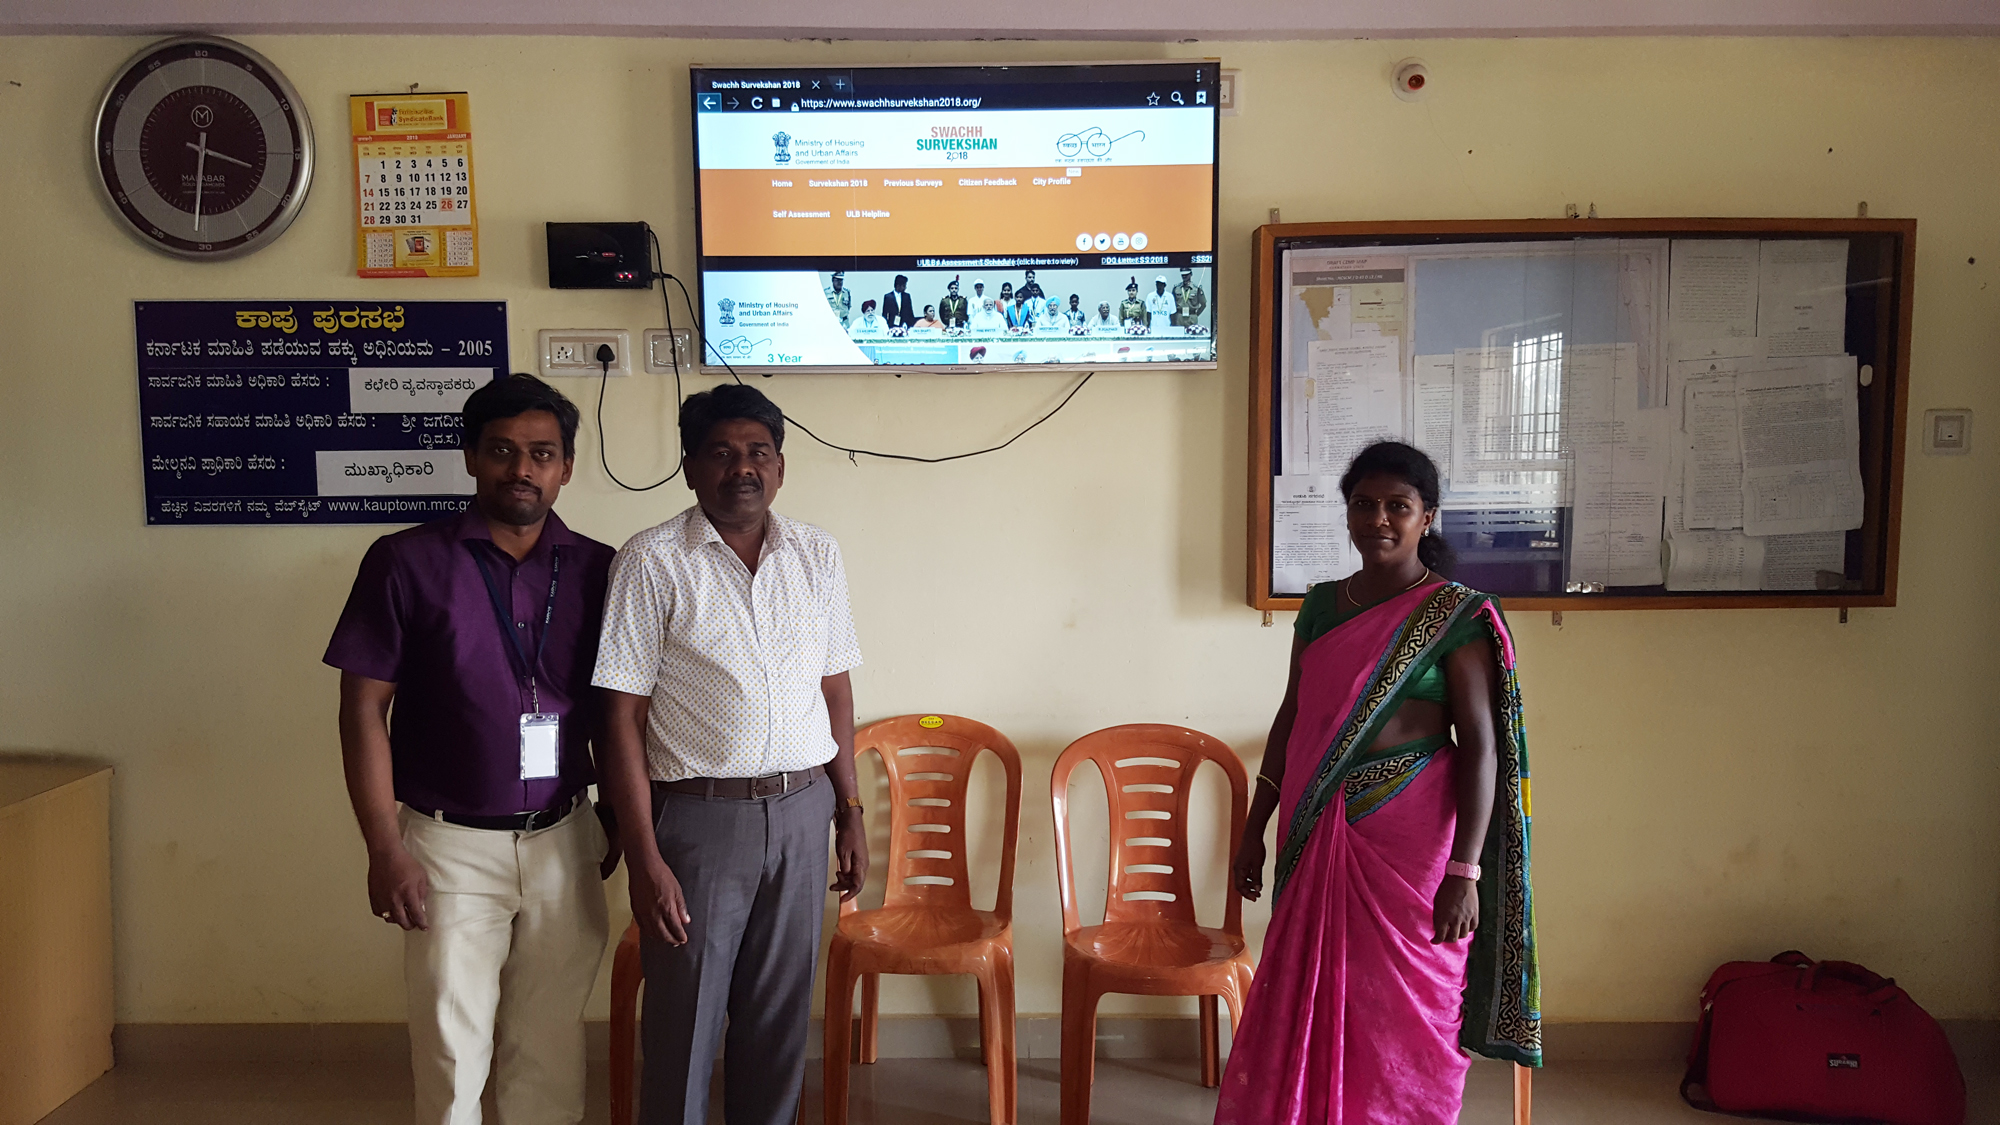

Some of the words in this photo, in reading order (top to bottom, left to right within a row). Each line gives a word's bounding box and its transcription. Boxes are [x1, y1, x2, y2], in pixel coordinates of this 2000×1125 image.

[712, 81, 739, 89] Swachh
[741, 81, 781, 89] Survekshan
[783, 81, 801, 89] 2018
[280, 98, 290, 112] 10
[801, 98, 981, 109] https://www.swachhsurvekshan2018.org/
[931, 126, 983, 138] SWACHH
[794, 139, 823, 147] Ministry
[834, 139, 864, 148] Housing
[916, 138, 998, 150] SURVEKSHAN
[835, 149, 858, 157] Affairs
[381, 161, 385, 169] 1
[396, 160, 401, 169] 2
[411, 160, 416, 168] 3
[427, 159, 432, 168] 4
[442, 159, 447, 167] 5
[457, 158, 463, 167] 6
[181, 174, 225, 183] MAABAR
[365, 175, 370, 183] 7
[381, 174, 386, 183] 8
[396, 174, 402, 182] 9
[409, 173, 420, 182] 10
[425, 173, 435, 182] 11
[440, 173, 451, 181] 12
[456, 172, 467, 181] 13
[772, 179, 793, 188] Home
[808, 179, 849, 187] Survekshan
[850, 179, 868, 187] 2018
[883, 179, 914, 187] Previous
[915, 179, 943, 188] Surveys
[958, 178, 982, 186] Citizen
[984, 178, 1017, 186] Feedback
[1032, 178, 1047, 187] City
[363, 189, 374, 197] 14
[379, 188, 389, 197] 15
[394, 188, 405, 196] 16
[410, 187, 420, 196] 17
[425, 187, 436, 196] 18
[441, 187, 452, 195] 19
[456, 186, 467, 195] 20
[364, 203, 375, 211] 21
[379, 202, 390, 210] 22
[395, 202, 406, 210] 23
[410, 201, 421, 210] 24
[426, 201, 437, 209] 25
[441, 201, 452, 209] 26
[457, 200, 468, 209] 27
[364, 216, 375, 224] 28
[380, 216, 390, 224] 29
[395, 215, 406, 224] 30
[410, 215, 421, 224] 31
[772, 210, 787, 218] Self
[788, 210, 831, 218] Assessment
[846, 210, 860, 218] ULB
[862, 210, 890, 219] Helpline
[151, 228, 164, 240] 35
[235, 305, 298, 333] ಕಾಪು
[312, 305, 405, 334] ಪುರಸಭೆ
[146, 339, 200, 356] ಕರ್ನಾಟಕ
[207, 339, 254, 356] ಮಾಹಿತಿ
[261, 338, 321, 356] ಪಡೆಯುವ
[328, 339, 358, 365] ಹಕ್ಕು
[363, 339, 434, 359] ಅಧಿನಿಯಮ
[458, 340, 493, 356] 2005
[768, 354, 774, 363] 3
[778, 354, 802, 363] Year
[148, 374, 201, 388] ಸಾರ್ವಜನಿಕ
[206, 374, 243, 388] ಮಾಹಿತಿ
[248, 375, 286, 389] ಅಧಿಕಾರಿ
[291, 373, 320, 387] ಹೆಸರು
[364, 379, 399, 391] ಕಛೇರಿ
[402, 378, 476, 397] ವ್ಯವಸ್ಥಾಪಕರು
[150, 414, 202, 428] ಸಾರ್ವಜನಿಕ
[207, 413, 250, 428] ಸಹಾಯಕ
[255, 413, 291, 428] ಮಾಹಿತಿ
[296, 414, 332, 430] ಅಧಿಕಾರಿ
[338, 412, 367, 428] ಹೆಸರು
[401, 415, 417, 433] ಶ್ರೀ
[423, 414, 464, 428] ಜಗದೀ
[152, 455, 197, 479] ಮೇಲ್ಮನವಿ
[201, 456, 243, 476] ಪ್ರಾಧಿಕಾರಿ
[248, 454, 276, 470] ಹೆಸರು
[344, 461, 434, 483] ಮುಖ್ಯಾಧಿಕಾರಿ
[161, 501, 188, 518] ಹೆಚ್ಚಿನ
[194, 501, 242, 512] ವಿವರಗಳಿಗೆ
[247, 501, 271, 518] ನಮ್ಮ
